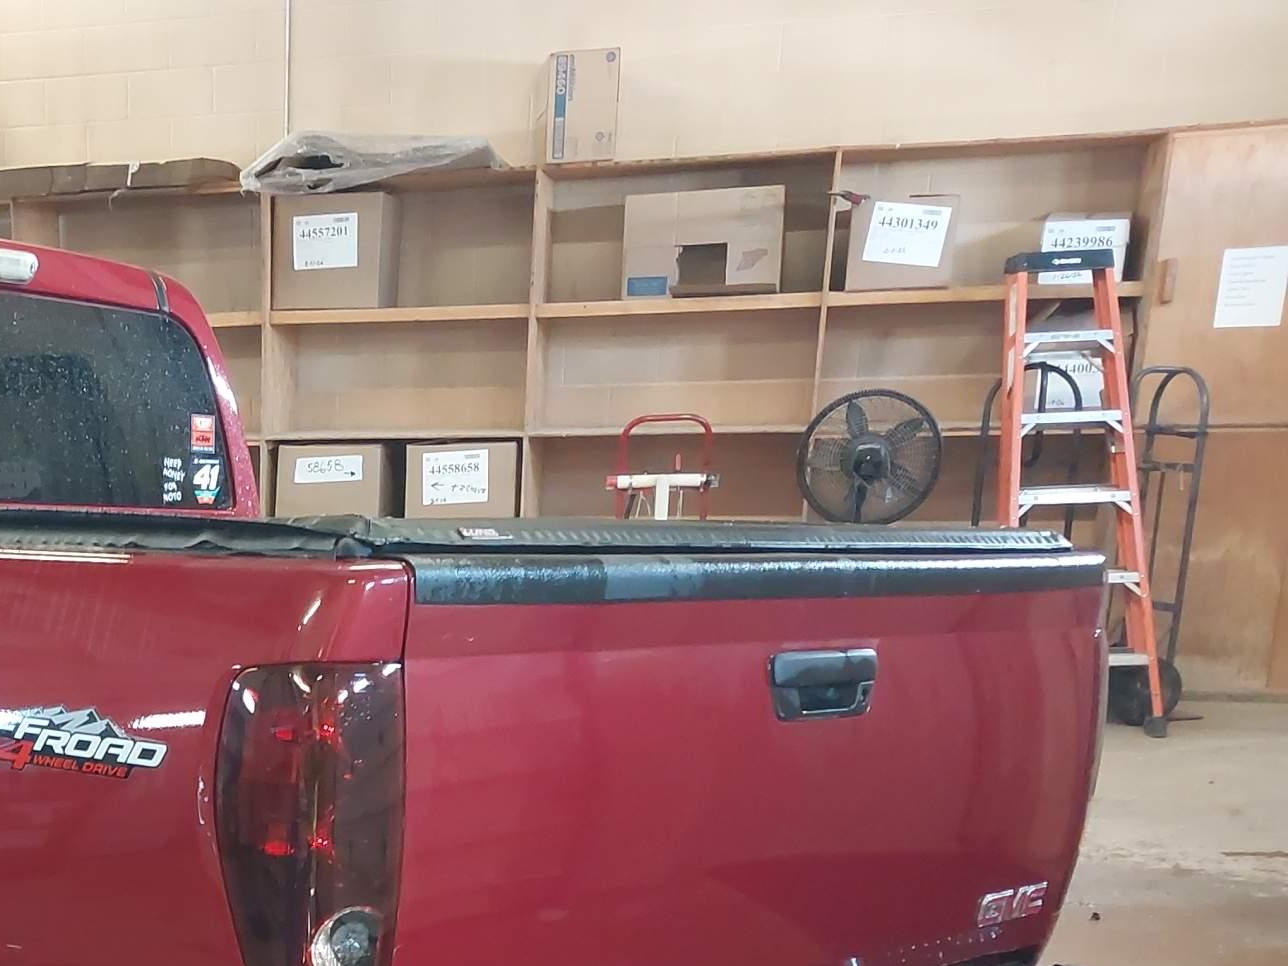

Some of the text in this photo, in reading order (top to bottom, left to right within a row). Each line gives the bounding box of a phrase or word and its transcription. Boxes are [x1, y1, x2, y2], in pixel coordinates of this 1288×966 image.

[878, 215, 939, 231] 44301349
[299, 225, 349, 240] 44557201
[1050, 236, 1114, 249] 44239986
[163, 456, 182, 470] NEED
[306, 458, 345, 474] 58658
[428, 462, 480, 475] 44558658
[192, 464, 220, 490] 41
[33, 731, 169, 767] ROAD
[32, 754, 80, 771] WHEEL
[82, 762, 129, 778] DRIVE
